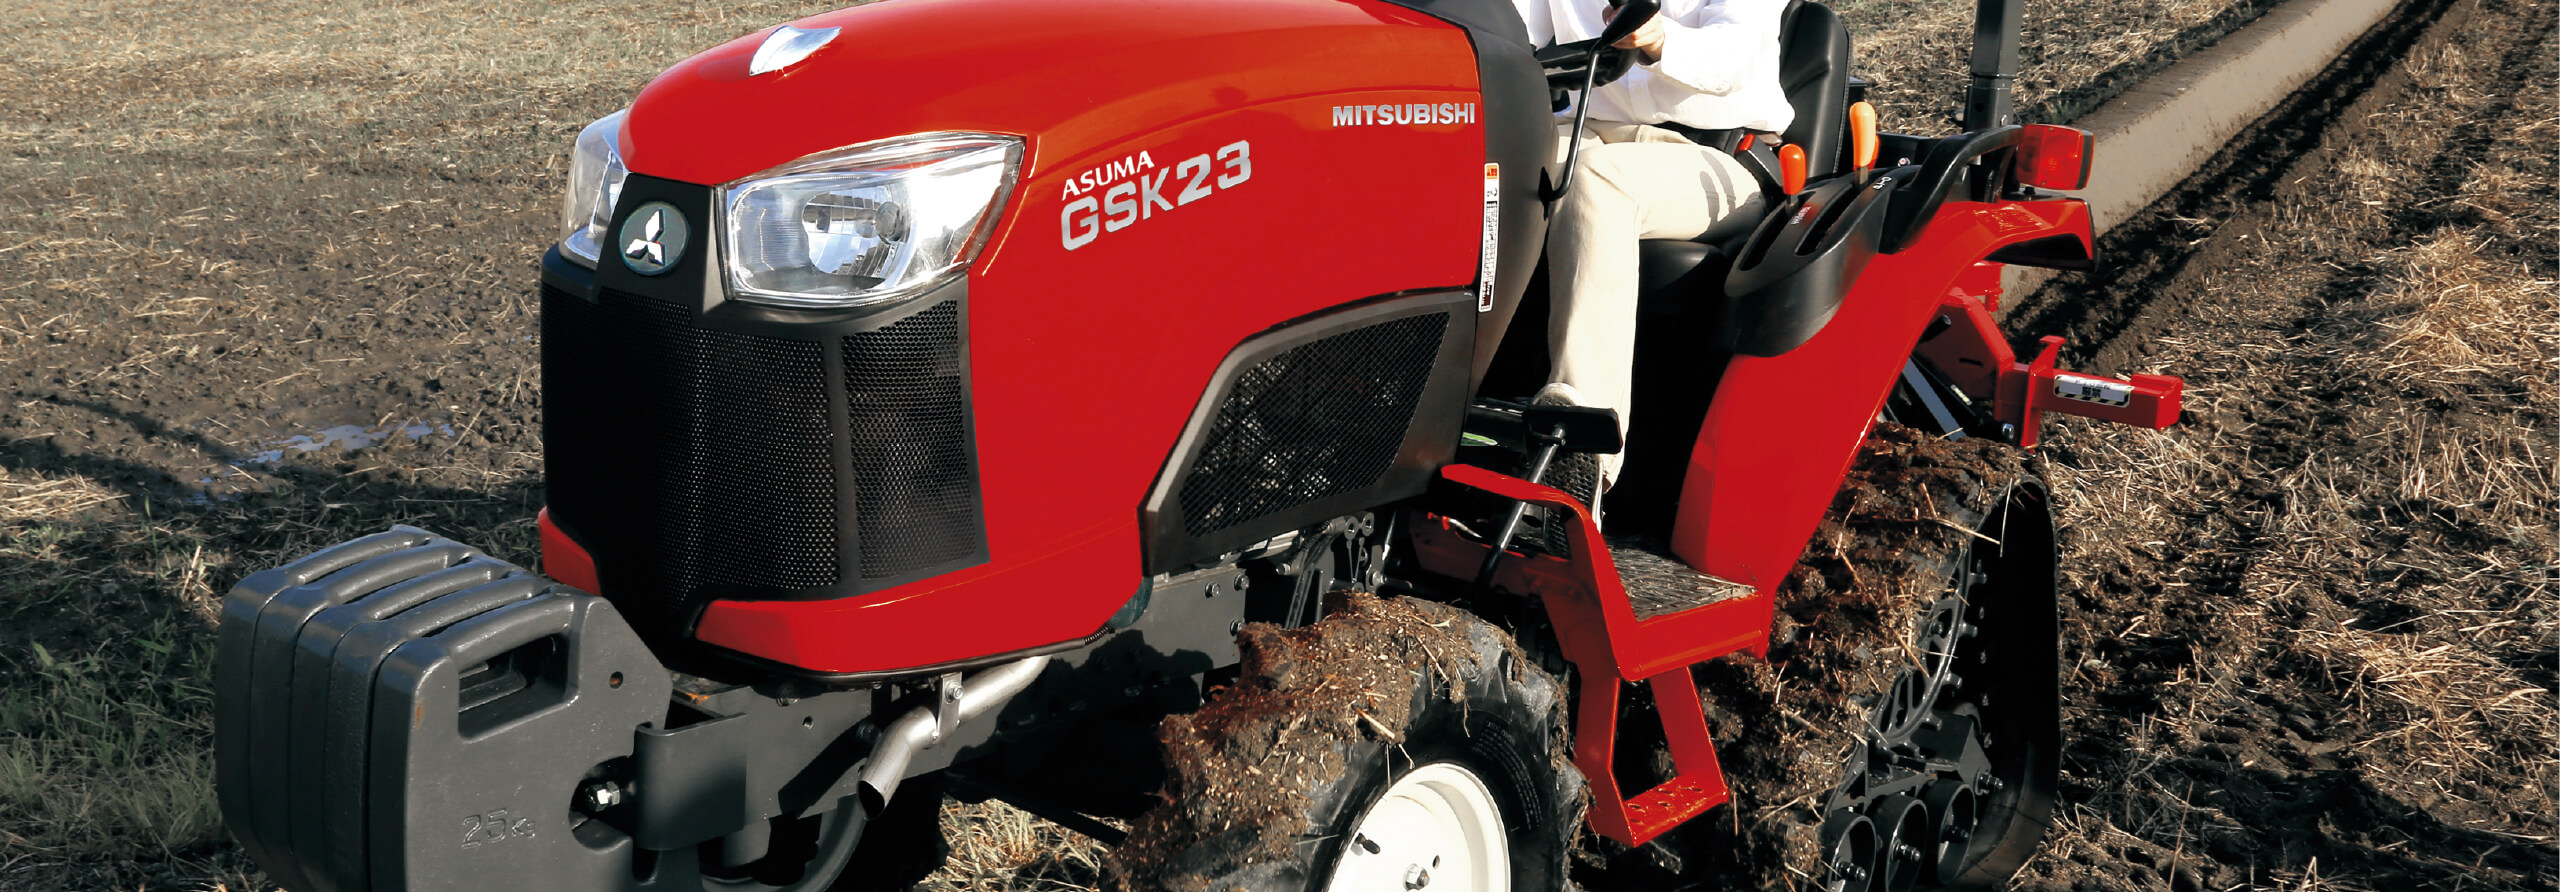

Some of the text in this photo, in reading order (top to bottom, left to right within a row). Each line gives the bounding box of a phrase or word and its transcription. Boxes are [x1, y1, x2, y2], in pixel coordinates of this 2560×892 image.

[1332, 103, 1475, 127] MITSUBISHI
[1061, 140, 1252, 251] GSK23
[1062, 150, 1155, 200] ASUMA
